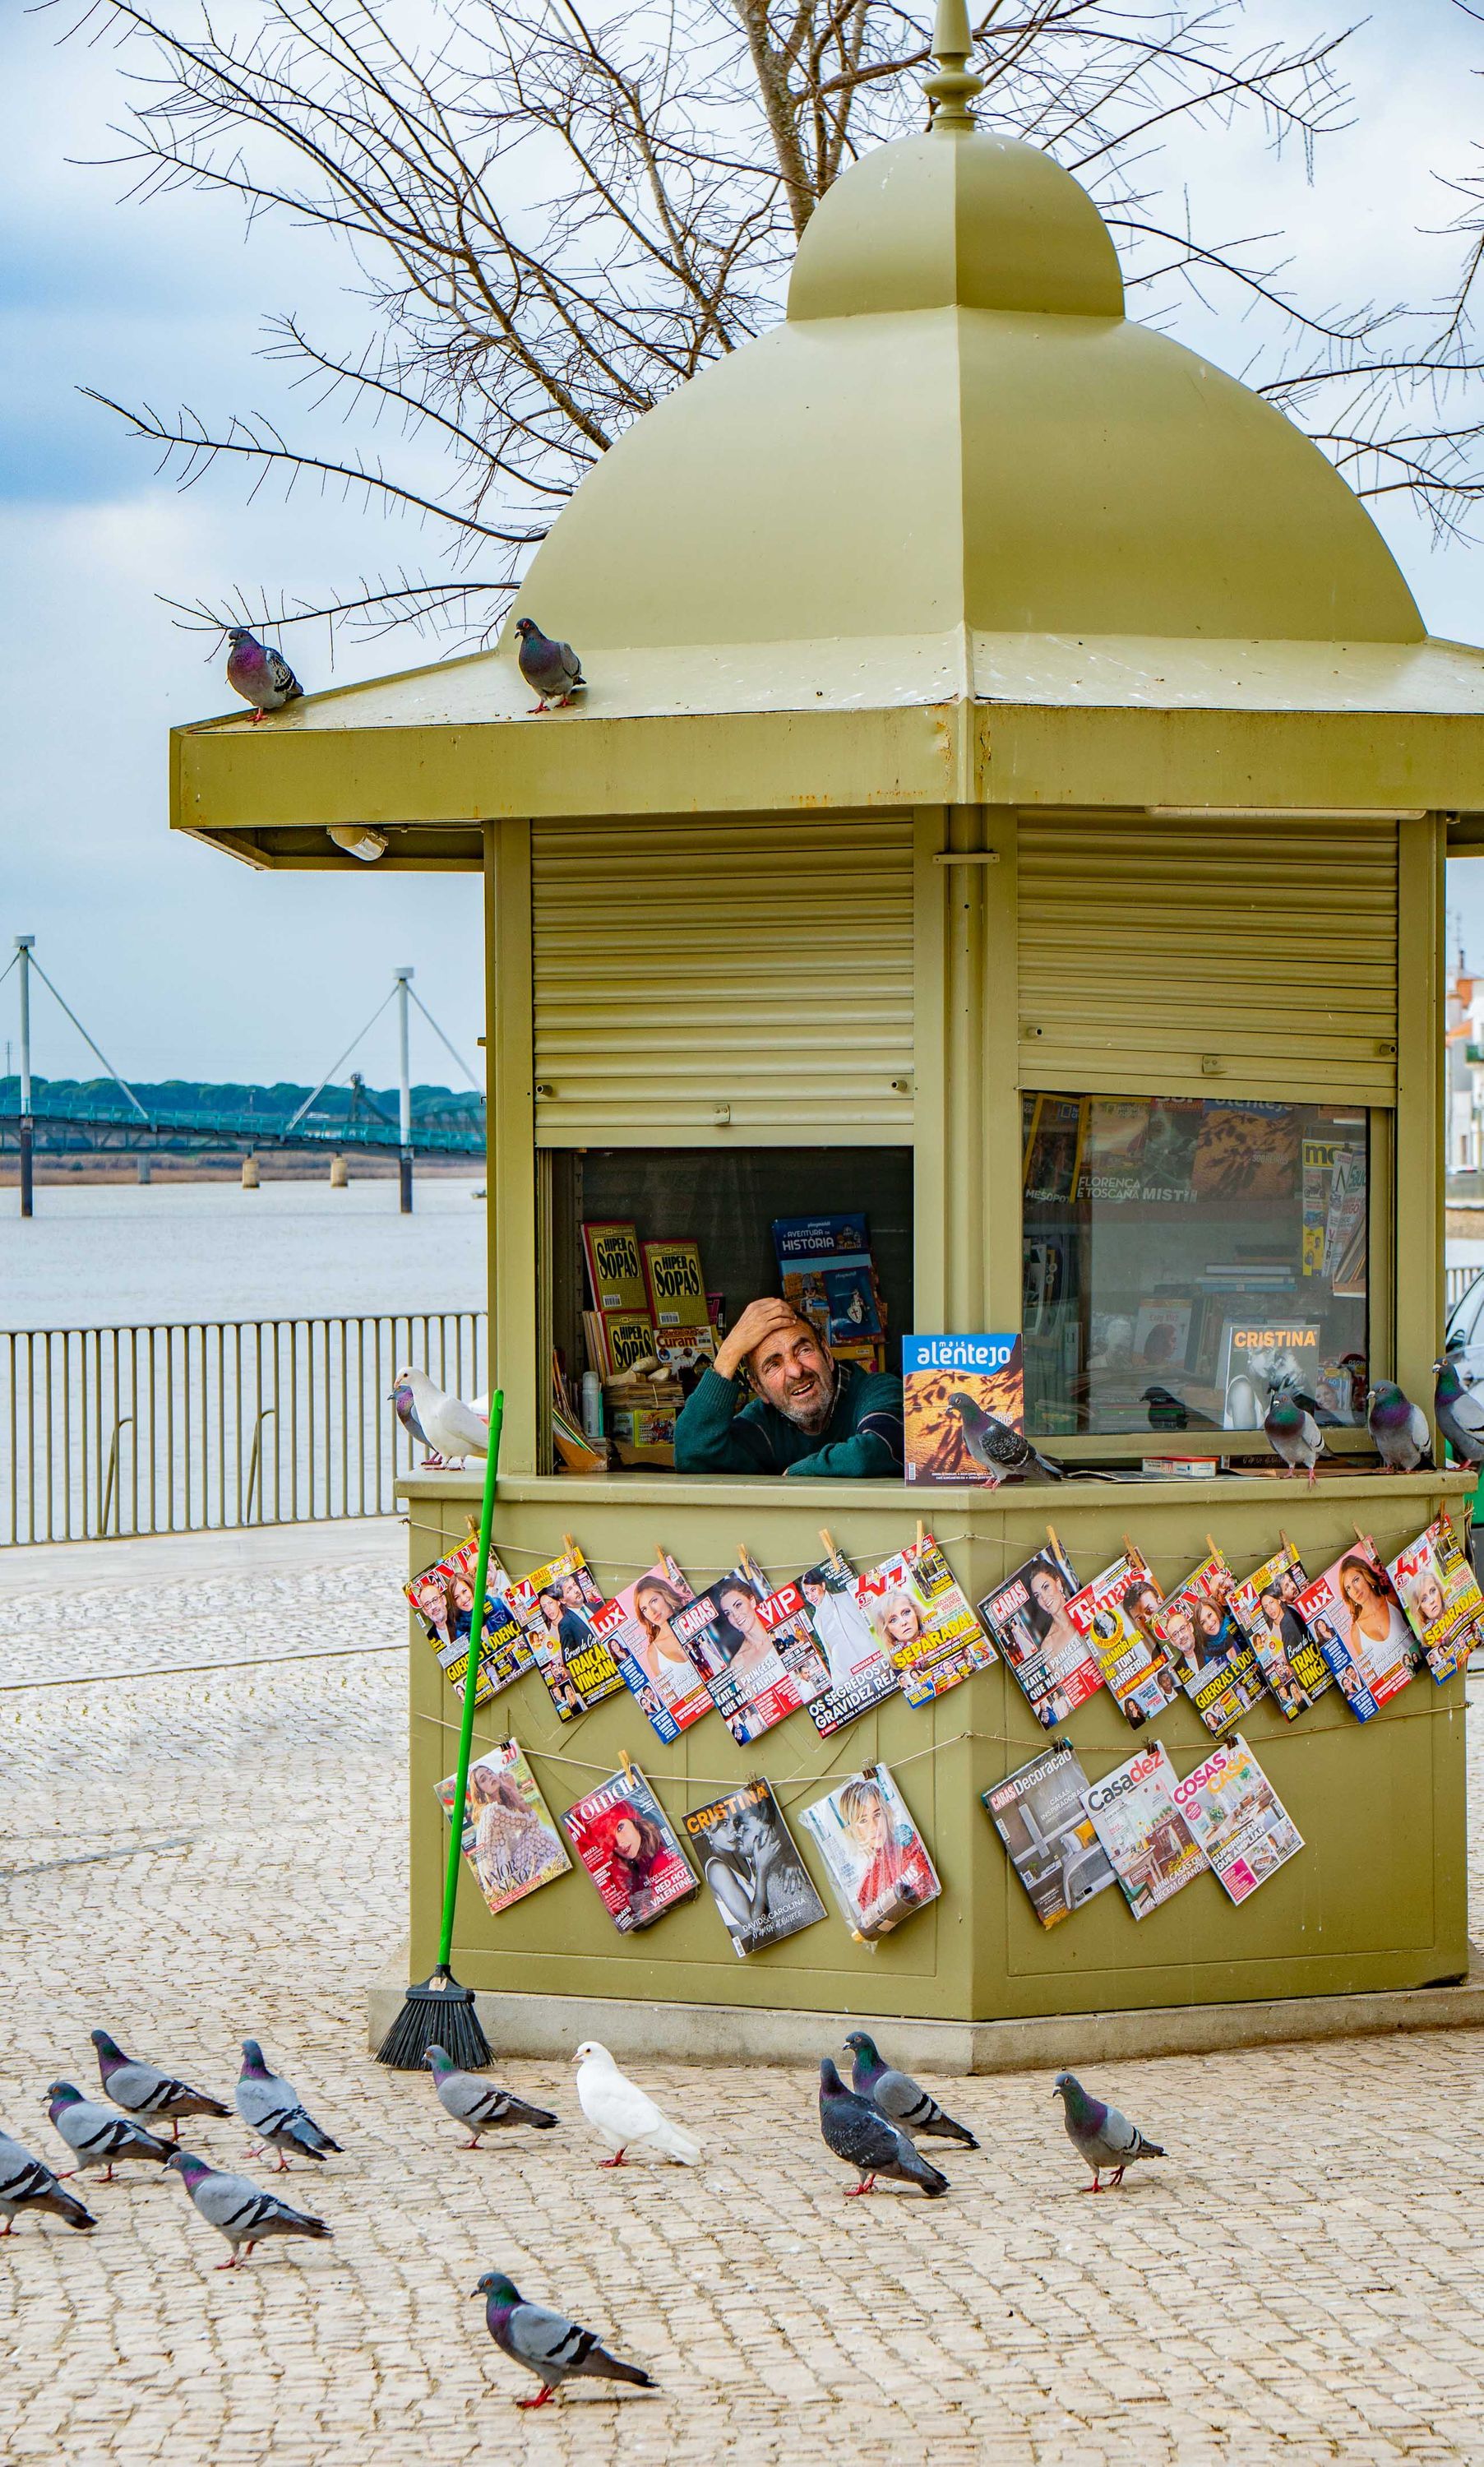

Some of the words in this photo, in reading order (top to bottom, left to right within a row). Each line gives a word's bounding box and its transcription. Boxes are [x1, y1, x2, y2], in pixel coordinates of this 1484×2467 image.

[1079, 1177, 1140, 1189] FLORENÇA
[1087, 1187, 1140, 1200] TOSCANA
[603, 1237, 626, 1252] HIPER
[782, 1237, 834, 1251] HISTÓRIA
[787, 1229, 823, 1238] AVENTURA
[597, 1240, 639, 1279] SOPAS
[662, 1256, 687, 1270] HIPER
[654, 1258, 700, 1297] SOPAS
[619, 1325, 641, 1340] HIPER
[657, 1335, 697, 1348] Curam
[1234, 1331, 1316, 1349] CRISTINA
[917, 1341, 1010, 1367] alentejo
[756, 1585, 802, 1628] VIP
[932, 1590, 959, 1608] DISCUSSÕES
[940, 1596, 961, 1611] VIOLENTAS
[992, 1581, 1029, 1621] CARAS
[677, 1598, 717, 1637] CARAS
[1423, 1586, 1481, 1646] SEPARADA!
[481, 1641, 491, 1655] E
[892, 1610, 974, 1669] SEPARADA!
[1101, 1628, 1144, 1668] NAMORADA
[851, 1656, 873, 1674] MEGHAN
[1023, 1669, 1045, 1691] KATE,
[1042, 1664, 1052, 1674] A
[1048, 1636, 1083, 1668] PRINCESA
[1028, 1682, 1047, 1701] QUE
[1042, 1669, 1061, 1688] NÃO
[1058, 1652, 1082, 1676] FALHA
[1103, 1666, 1117, 1680] de
[1115, 1649, 1138, 1670] TONY
[1109, 1655, 1149, 1690] CARREIRA
[1123, 1676, 1140, 1692] vivem
[1137, 1664, 1157, 1682] juntos
[1364, 1671, 1376, 1683] sou
[714, 1686, 736, 1706] KATE,
[734, 1682, 742, 1692] A
[740, 1656, 776, 1686] PRINCESA
[720, 1699, 738, 1717] QUE
[734, 1687, 753, 1706] NÃO
[751, 1671, 776, 1694] FALHA
[807, 1698, 826, 1717] OS
[823, 1662, 882, 1706] SEGREDOS
[1194, 1670, 1235, 1710] GUERRAS
[1231, 1665, 1240, 1676] E
[663, 1693, 676, 1705] sou
[813, 1683, 874, 1730] GRAVIDEZ
[842, 1710, 855, 1721] VOLTA
[989, 1784, 1018, 1810] CARAS
[1012, 1748, 1074, 1795] Decoração
[1171, 1751, 1228, 1806] COSAS
[1205, 1749, 1251, 1796] CASA
[564, 1772, 640, 1839] Woman
[684, 1783, 770, 1835] CRISTINA
[1040, 1786, 1085, 1821] INSPIRADORAS
[582, 1844, 598, 1858] BELEZA
[1215, 1853, 1234, 1871] QUE
[1232, 1825, 1266, 1858] AMPLÍAN
[650, 1873, 659, 1882] DOS
[658, 1857, 683, 1877] NAMORADOS
[654, 1877, 673, 1895] RED
[670, 1866, 690, 1883] HOT
[1152, 1877, 1171, 1893] MINI
[1168, 1861, 1192, 1881] CASAS
[650, 1874, 694, 1907] VALENTINE
[1144, 1881, 1179, 1909] PARECEM
[614, 1905, 631, 1923] GRÁTIS
